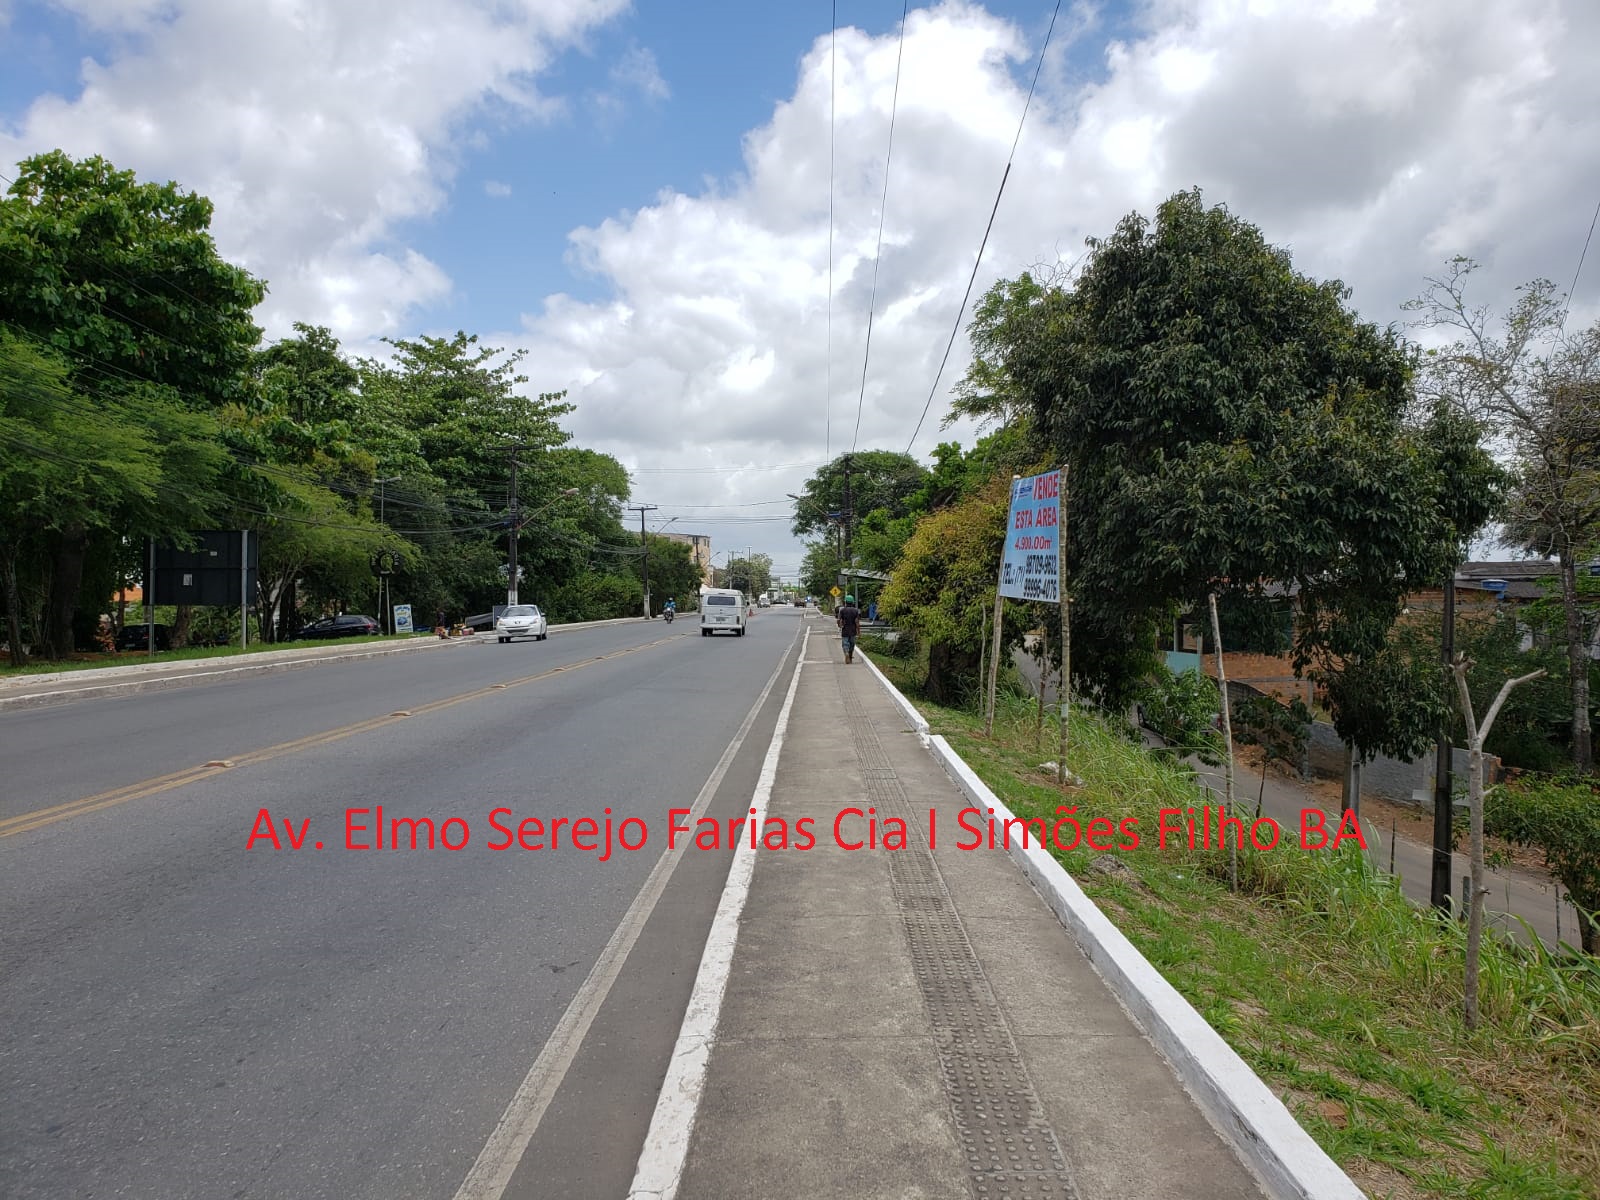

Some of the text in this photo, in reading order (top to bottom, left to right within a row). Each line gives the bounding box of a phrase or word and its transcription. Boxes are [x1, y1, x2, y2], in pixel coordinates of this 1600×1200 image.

[1033, 473, 1059, 500] VENDE
[1015, 504, 1057, 529] ESTA ÁREA
